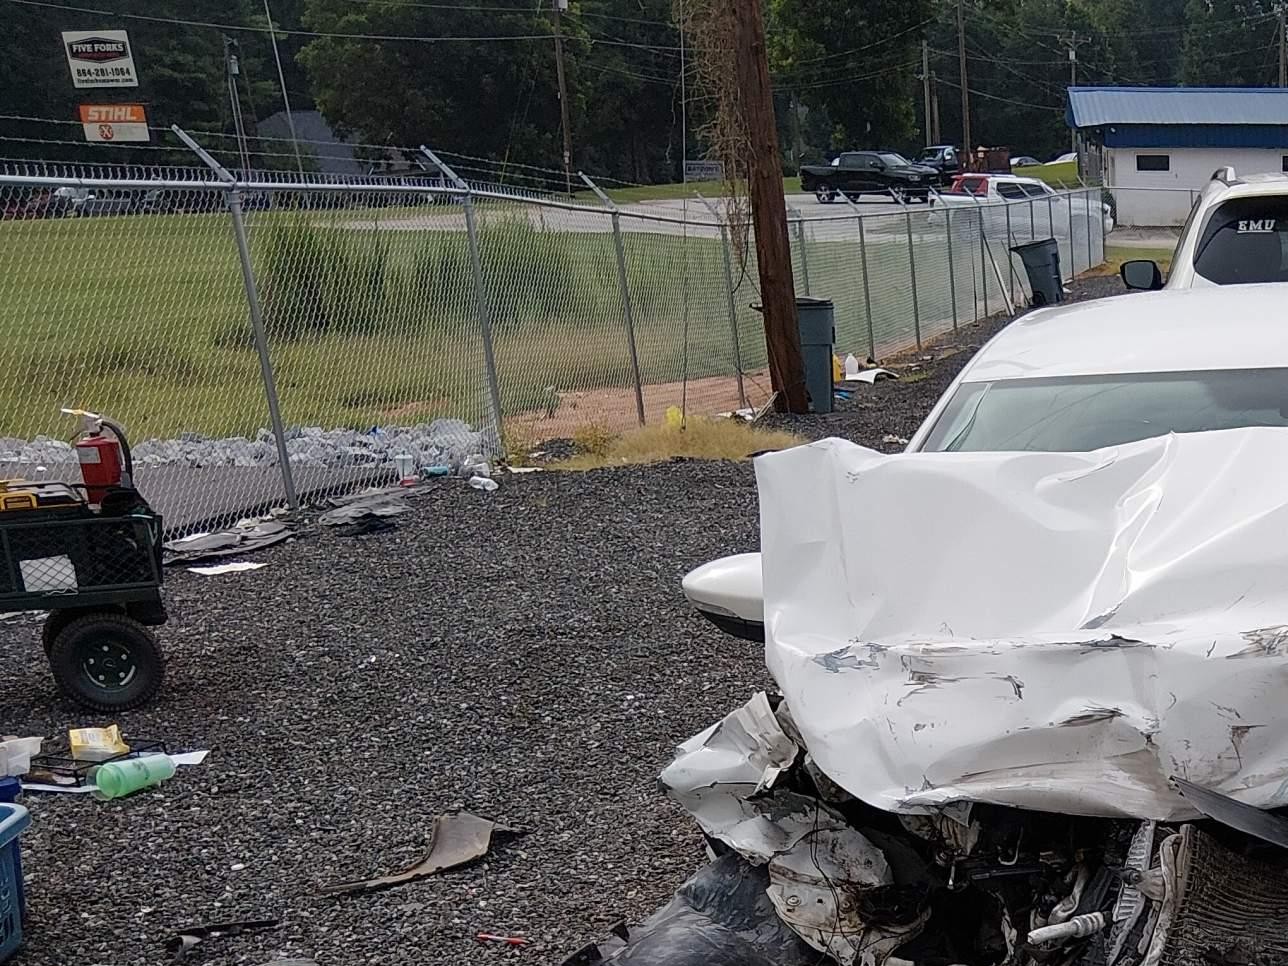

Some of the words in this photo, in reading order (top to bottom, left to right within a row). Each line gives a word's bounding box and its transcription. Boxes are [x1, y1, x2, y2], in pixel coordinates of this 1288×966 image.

[72, 44, 93, 53] FIVE
[94, 43, 124, 52] FORKS
[87, 106, 137, 121] STIHL
